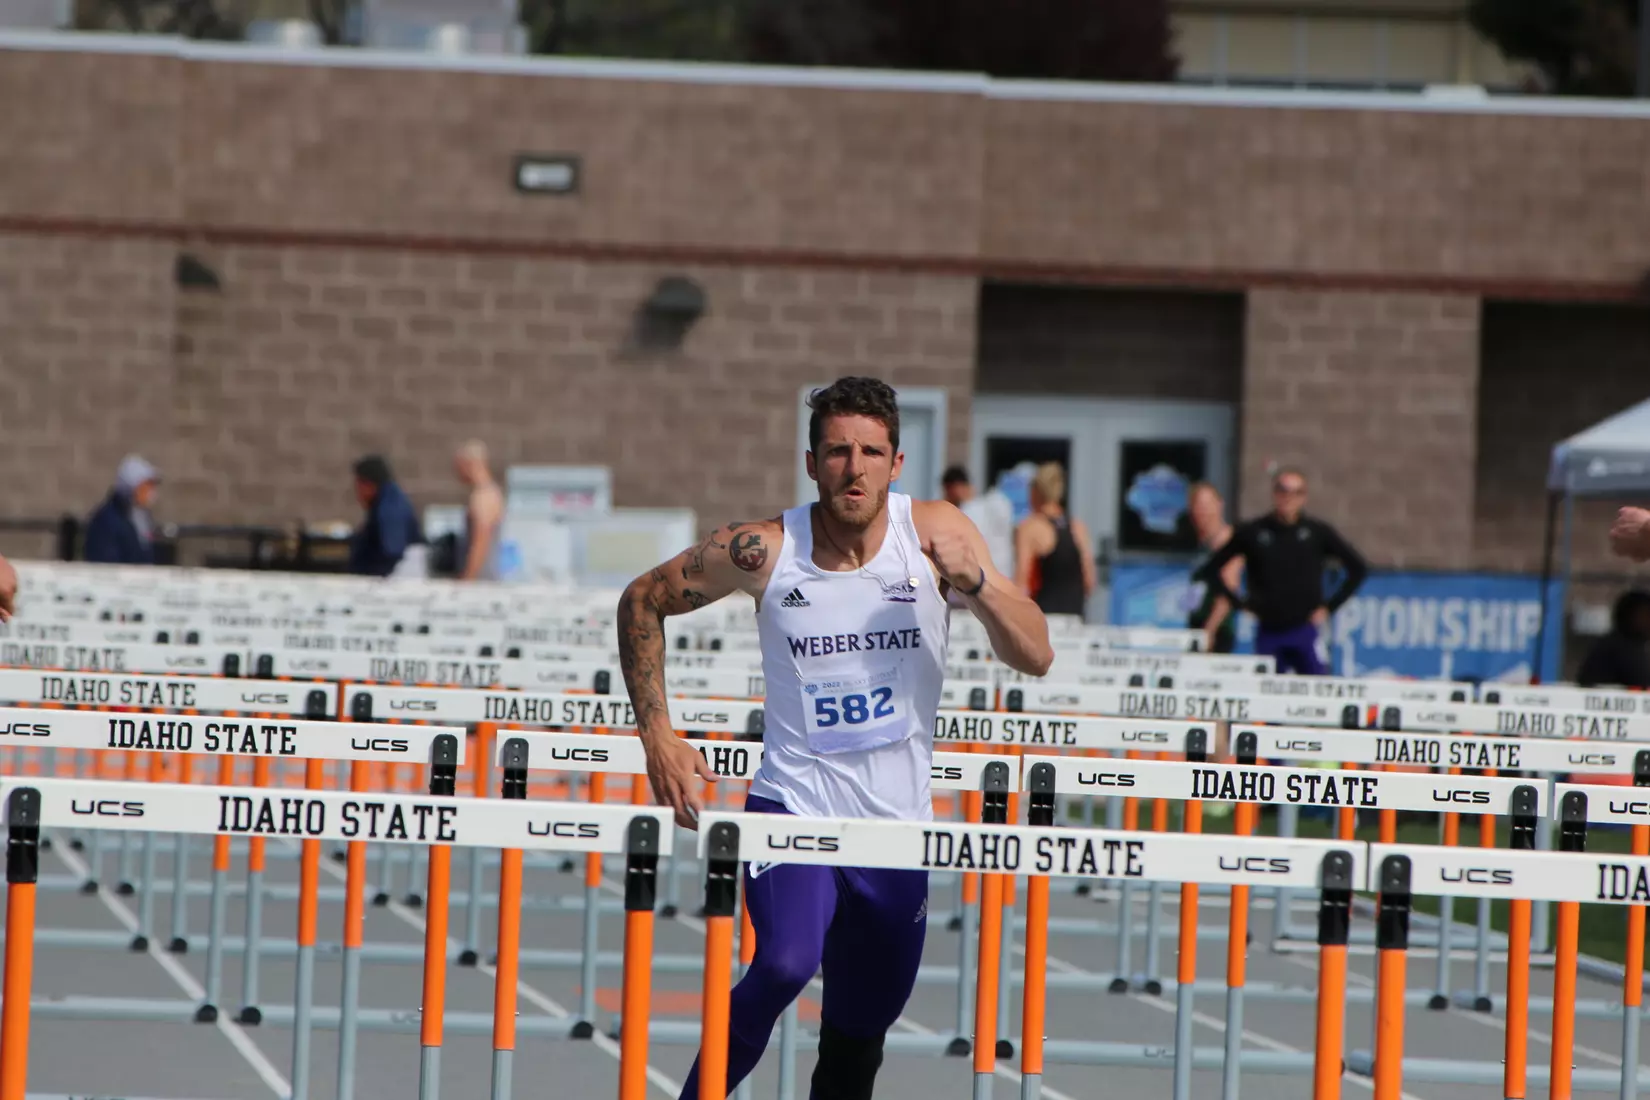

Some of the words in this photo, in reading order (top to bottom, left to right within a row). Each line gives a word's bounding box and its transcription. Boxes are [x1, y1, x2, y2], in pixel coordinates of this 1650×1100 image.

[781, 600, 810, 608] adidas
[787, 633, 862, 659] WEBER
[864, 627, 921, 650] STATE
[63, 646, 128, 671] STATE
[370, 658, 428, 682] IDAHO
[436, 661, 500, 686] STATE
[41, 677, 111, 702] IDAHO
[120, 681, 197, 707] STATE
[241, 691, 289, 704] UCS
[389, 699, 438, 711] UCS
[484, 696, 553, 721] IDAHO
[562, 700, 637, 725] STATE
[815, 686, 895, 728] 582
[1119, 692, 1178, 715] IDAHO
[1185, 697, 1250, 719] STATE
[682, 712, 729, 723] UCS
[1497, 711, 1557, 734] IDAHO
[1563, 714, 1629, 738] STATE
[108, 719, 193, 750] IDAHO
[204, 724, 297, 755] STATE
[934, 716, 993, 741] DAHO
[1002, 719, 1077, 745] STATE
[1121, 731, 1169, 743] UCS
[351, 737, 409, 752] UCS
[1275, 740, 1323, 752] UCS
[1375, 738, 1441, 764] IDAHO
[1449, 741, 1521, 768] STATE
[551, 747, 609, 762] UCS
[1568, 753, 1616, 765] UCS
[930, 766, 963, 780] CS
[1078, 771, 1136, 787] UCS
[1191, 769, 1276, 802] IDAHO
[1286, 774, 1379, 806] STATE
[1433, 788, 1491, 804] UCS
[71, 798, 145, 817] UCS
[1609, 801, 1650, 815] UC
[218, 794, 326, 836] IDAHO
[341, 801, 458, 842] STATE
[527, 820, 600, 839] UCS
[767, 833, 840, 852] UCS
[921, 830, 1022, 870] IDAHO
[1035, 836, 1145, 877] STATE
[1218, 854, 1291, 873] UCS
[1440, 867, 1515, 885] UCS
